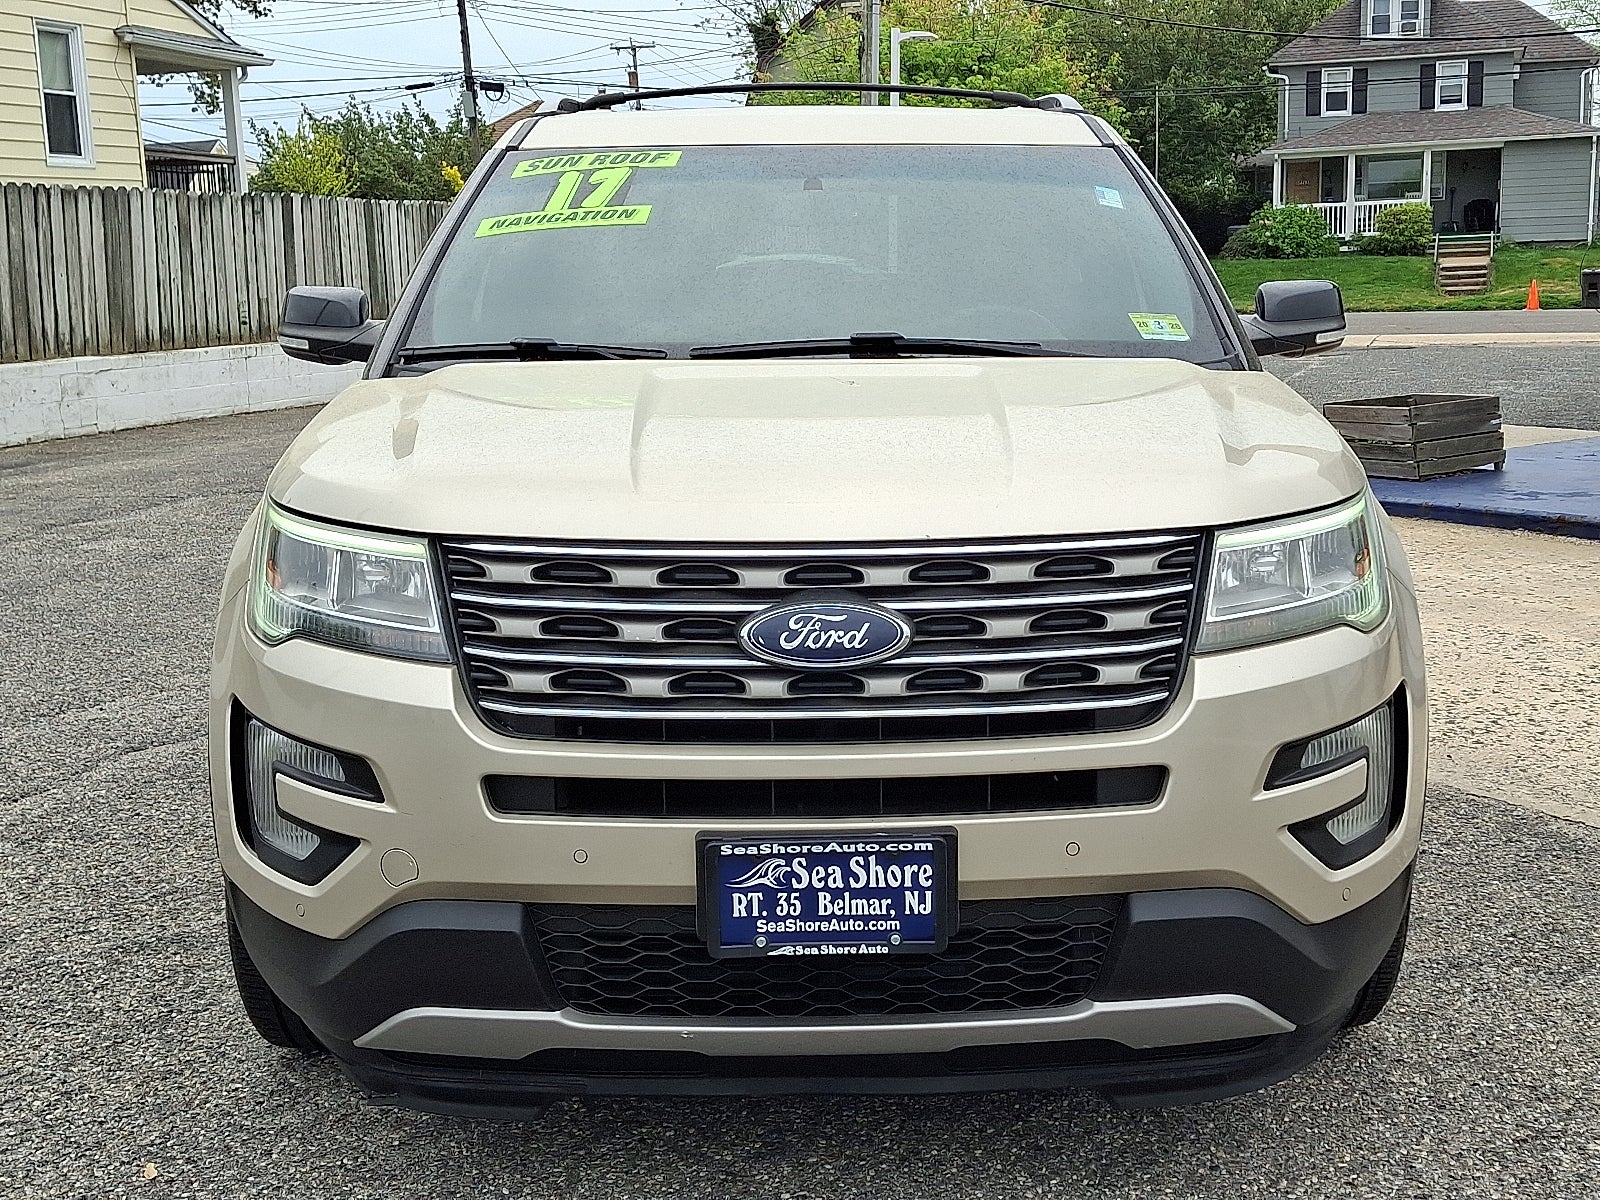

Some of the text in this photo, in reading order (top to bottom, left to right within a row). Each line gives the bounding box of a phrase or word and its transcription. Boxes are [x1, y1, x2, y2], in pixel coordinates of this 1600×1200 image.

[523, 152, 671, 173] SUN ROOF
[543, 166, 633, 212] 17
[488, 208, 638, 230] NAVIGATION
[1153, 320, 1164, 330] 3
[779, 613, 871, 650] Ford
[720, 842, 934, 856] SeaShoreAuto.com
[791, 855, 933, 889] Sea Shore
[731, 890, 933, 918] RT. 35 Belmar, NJ
[756, 918, 901, 934] SeaShoreAuto.com
[795, 943, 889, 955] Sea Shore Auto
